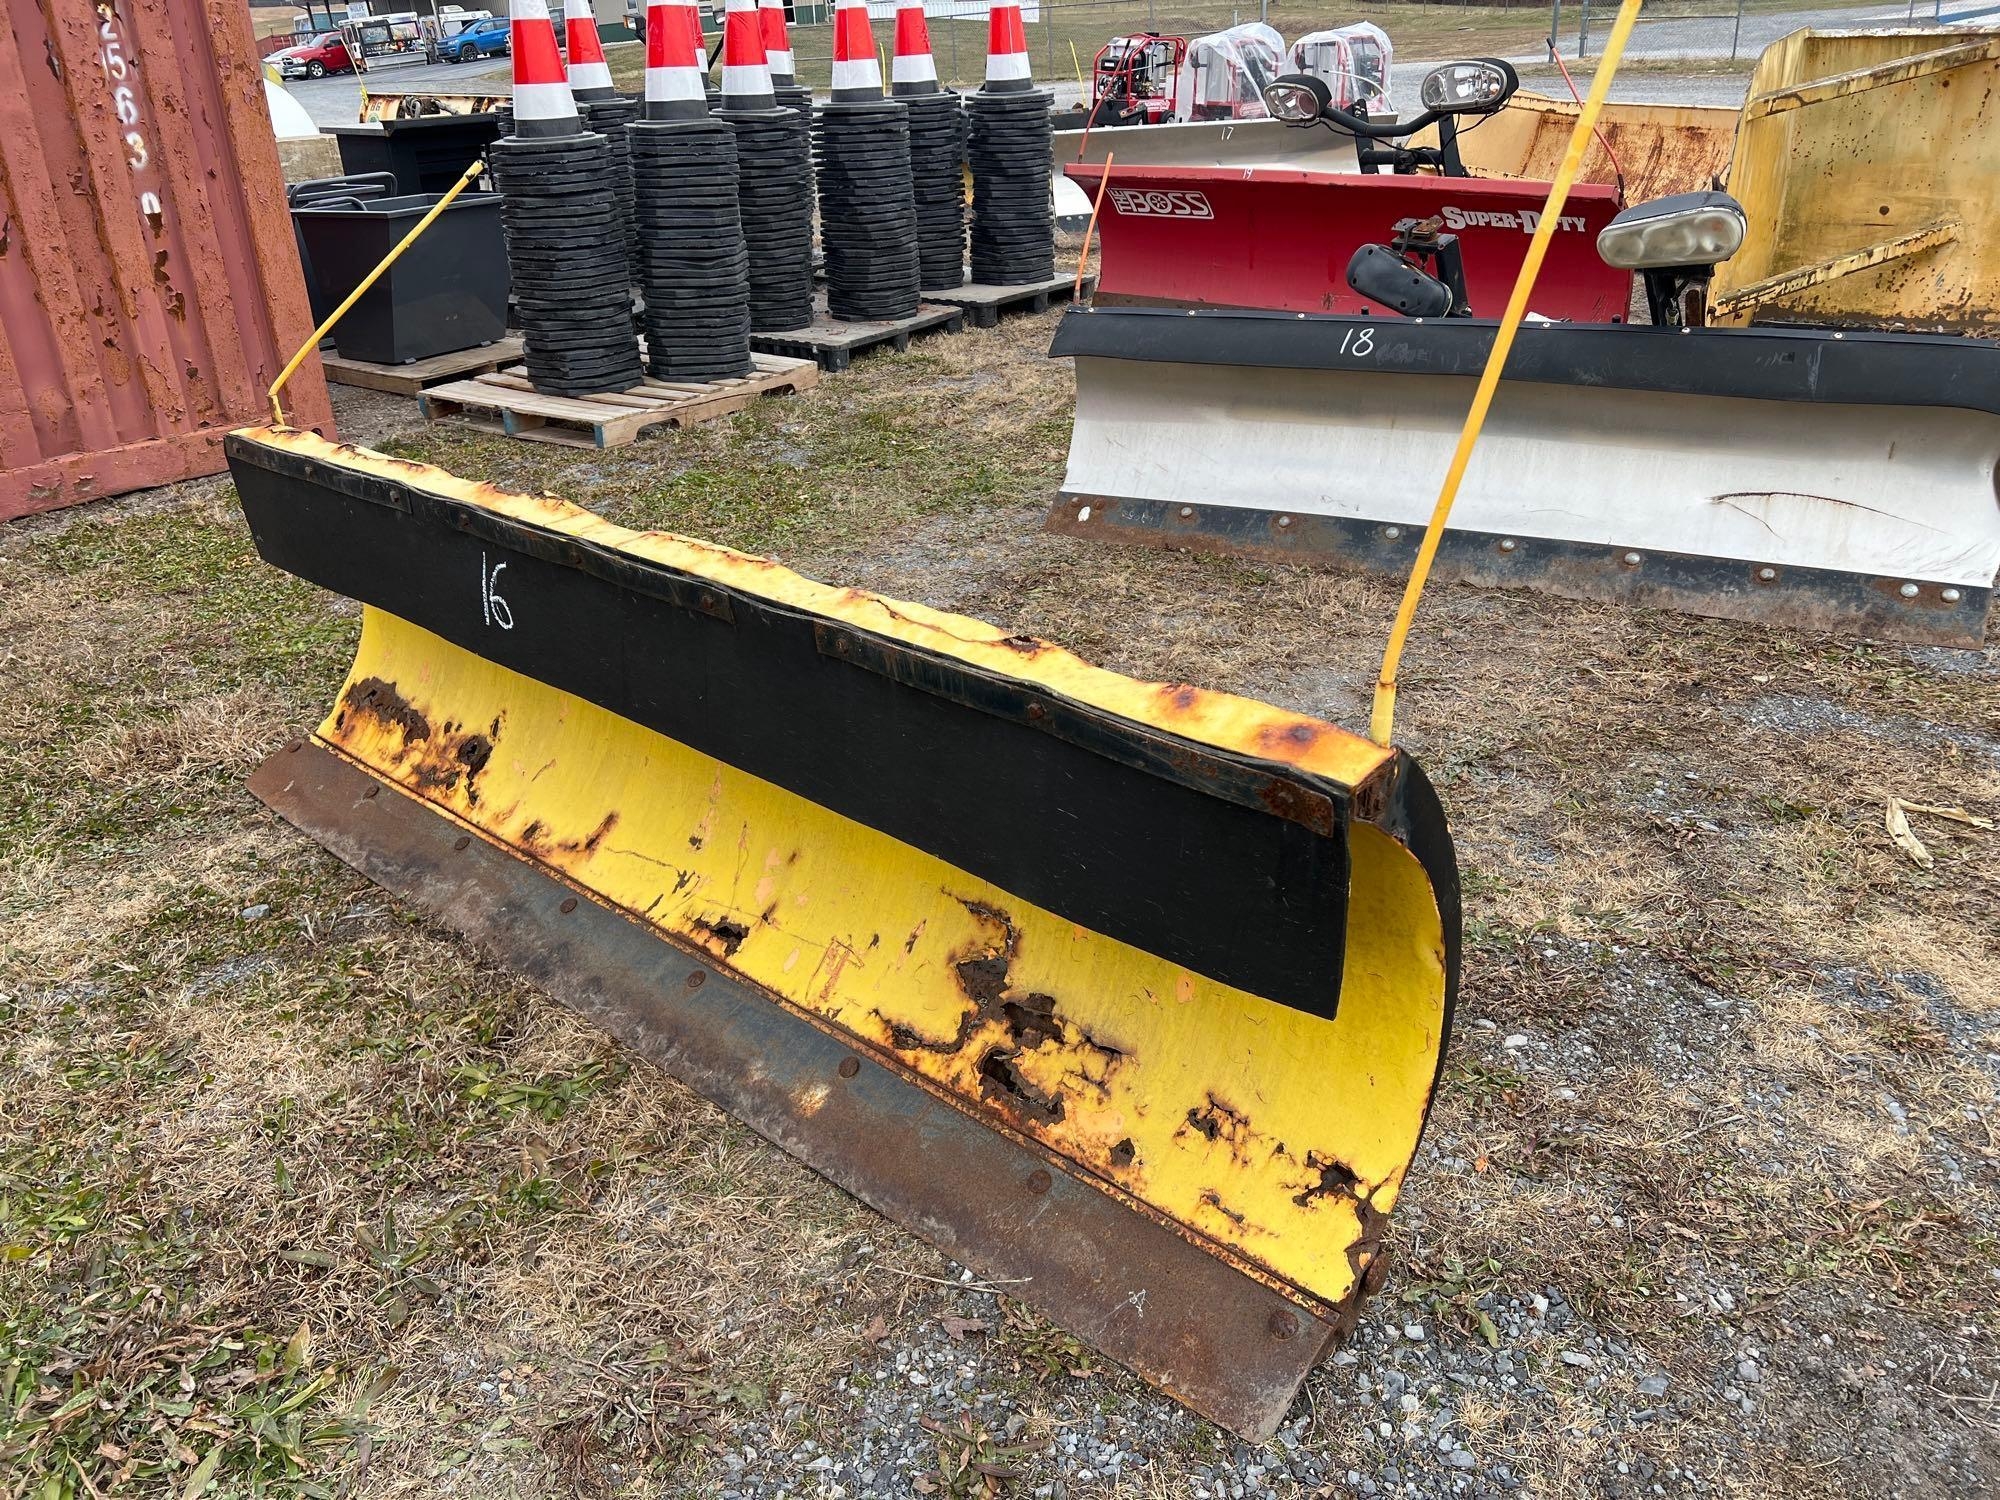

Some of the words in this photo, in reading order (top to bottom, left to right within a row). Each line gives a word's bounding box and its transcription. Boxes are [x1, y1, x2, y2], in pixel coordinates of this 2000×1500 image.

[1221, 126, 1234, 141] 17
[1111, 190, 1133, 212] THE
[1124, 190, 1209, 216] BOSS
[1441, 206, 1586, 234] SUPER-DTY
[1339, 327, 1375, 357] 18
[481, 551, 514, 630] 16
